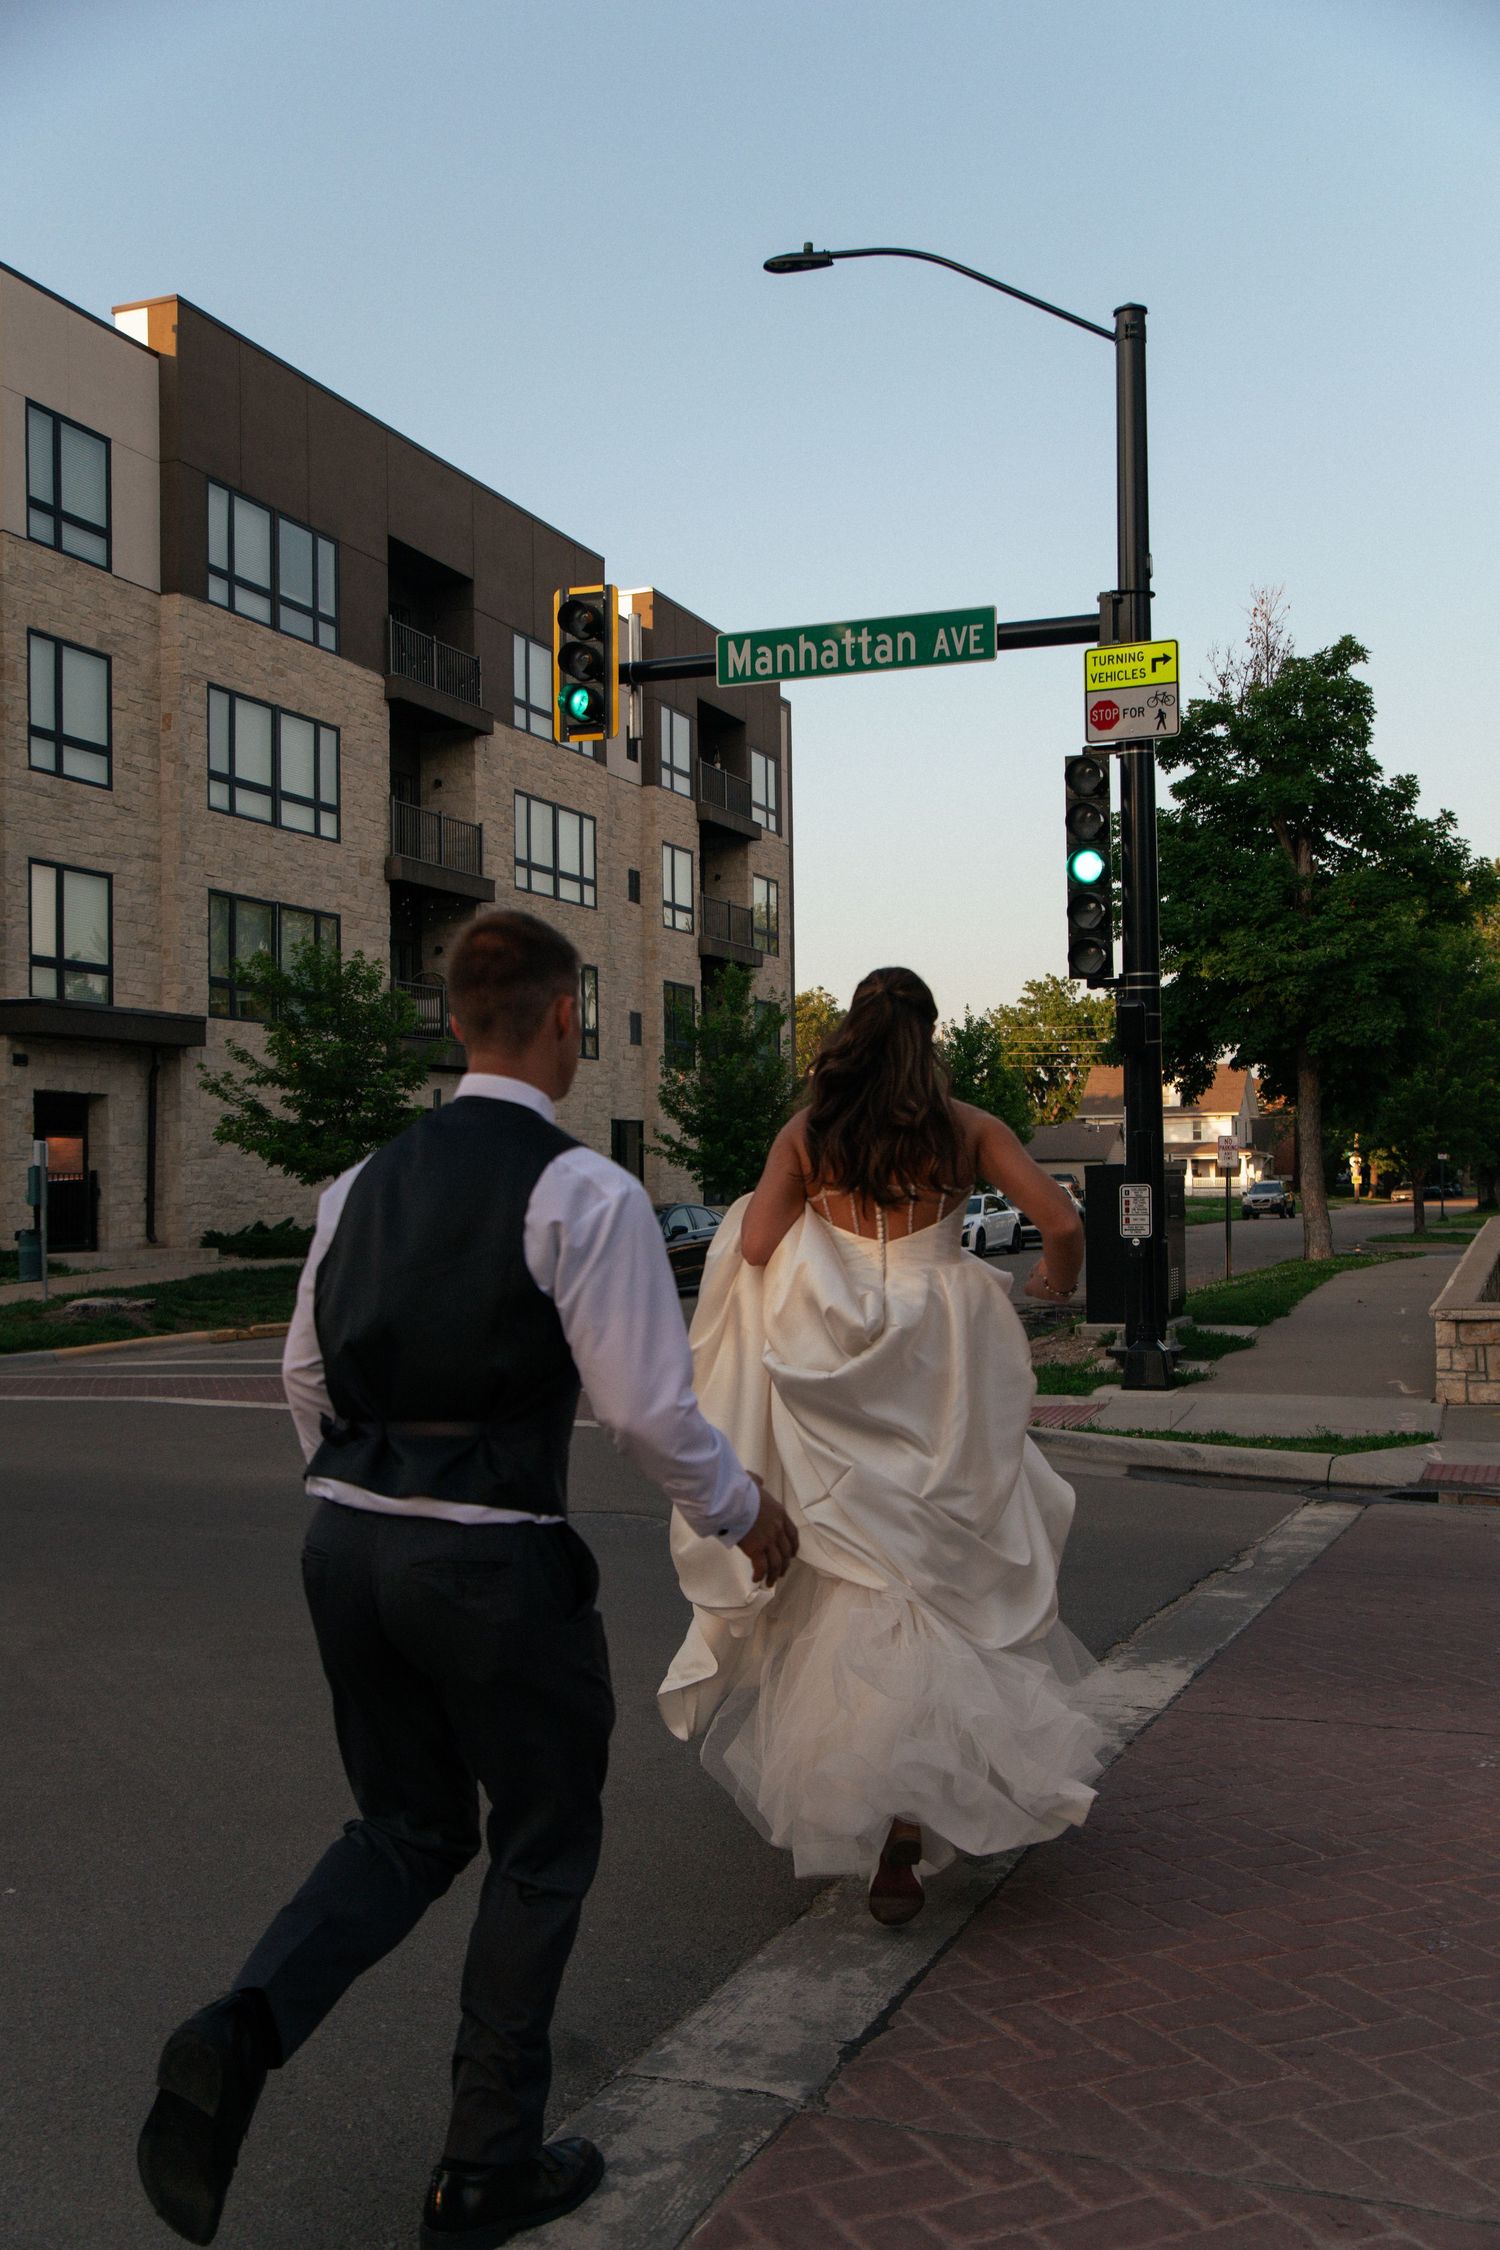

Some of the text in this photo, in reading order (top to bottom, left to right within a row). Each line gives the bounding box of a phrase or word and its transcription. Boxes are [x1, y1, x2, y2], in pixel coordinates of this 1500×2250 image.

[727, 624, 985, 679] Manhattan AVE
[1092, 651, 1144, 666] TURNING
[1091, 668, 1146, 683] VEHICLES
[1092, 707, 1145, 722] STOP FOR
